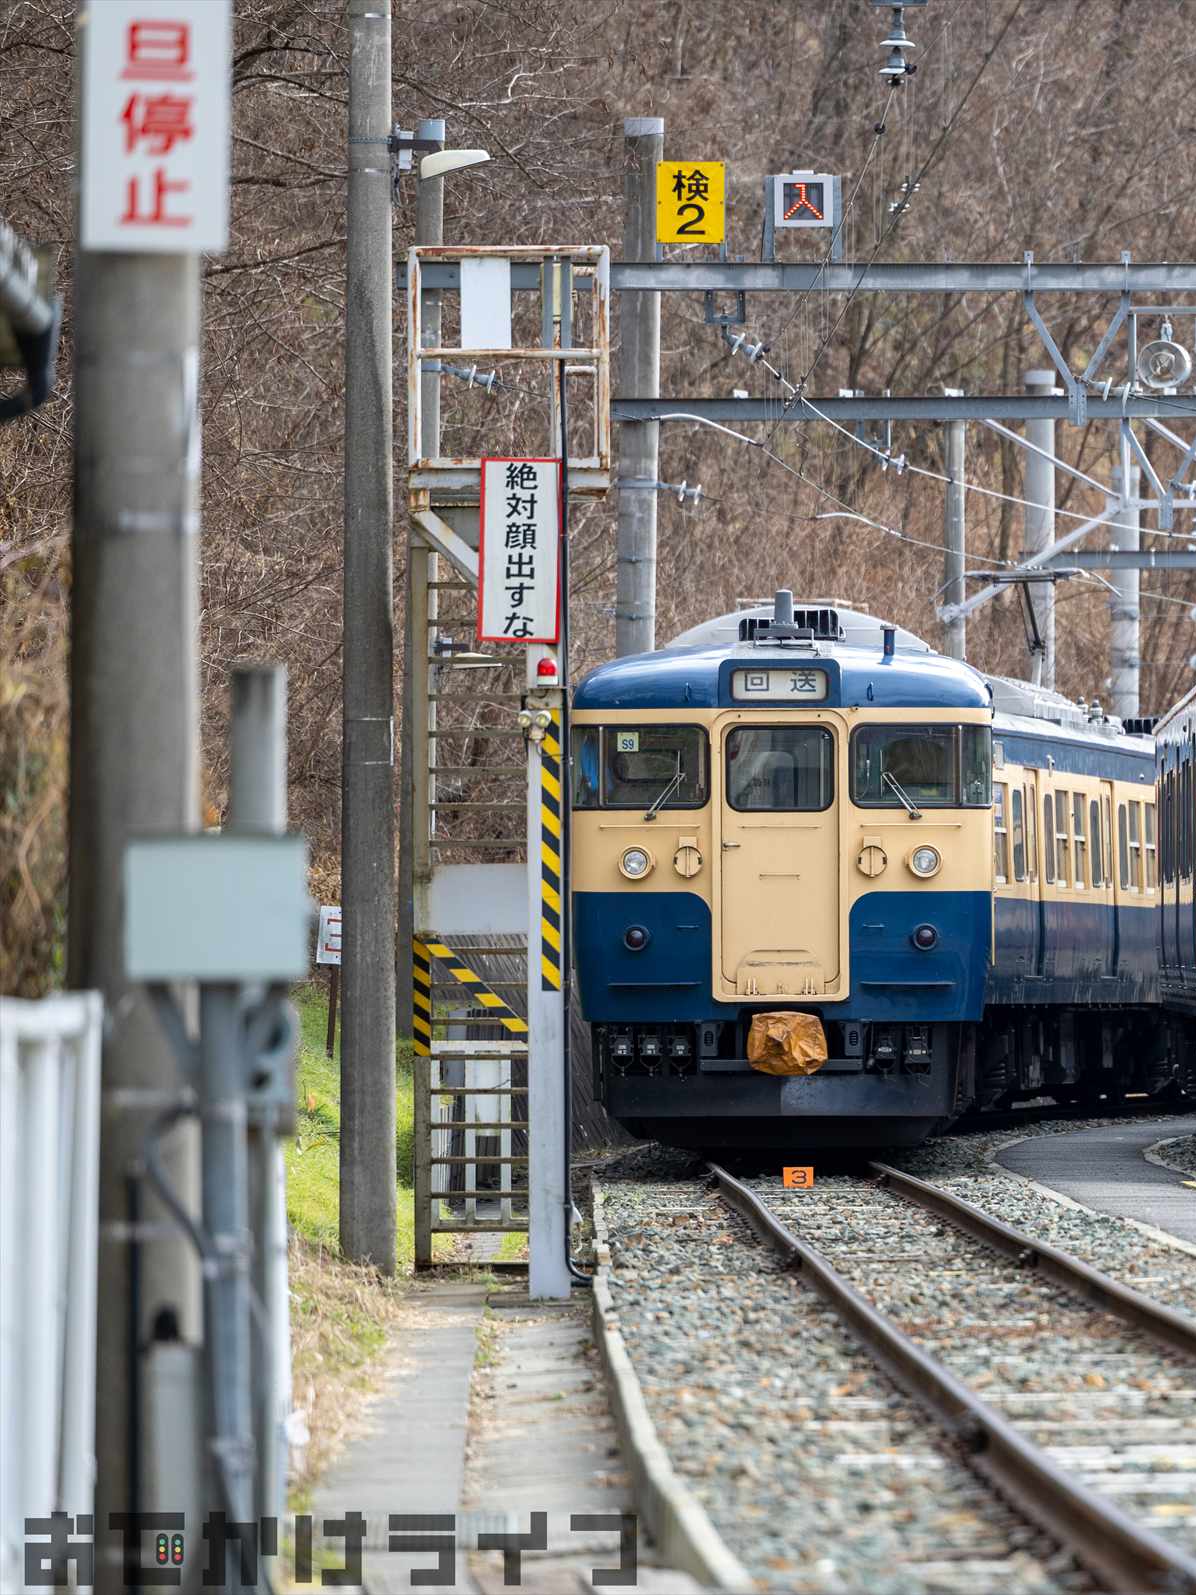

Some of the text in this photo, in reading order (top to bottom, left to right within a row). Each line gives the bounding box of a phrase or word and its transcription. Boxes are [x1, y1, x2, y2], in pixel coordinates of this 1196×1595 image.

[120, 19, 193, 228] 旦停止
[503, 462, 538, 638] 絶対顔出すな
[744, 671, 817, 693] 回送
[791, 1170, 807, 1185] 3
